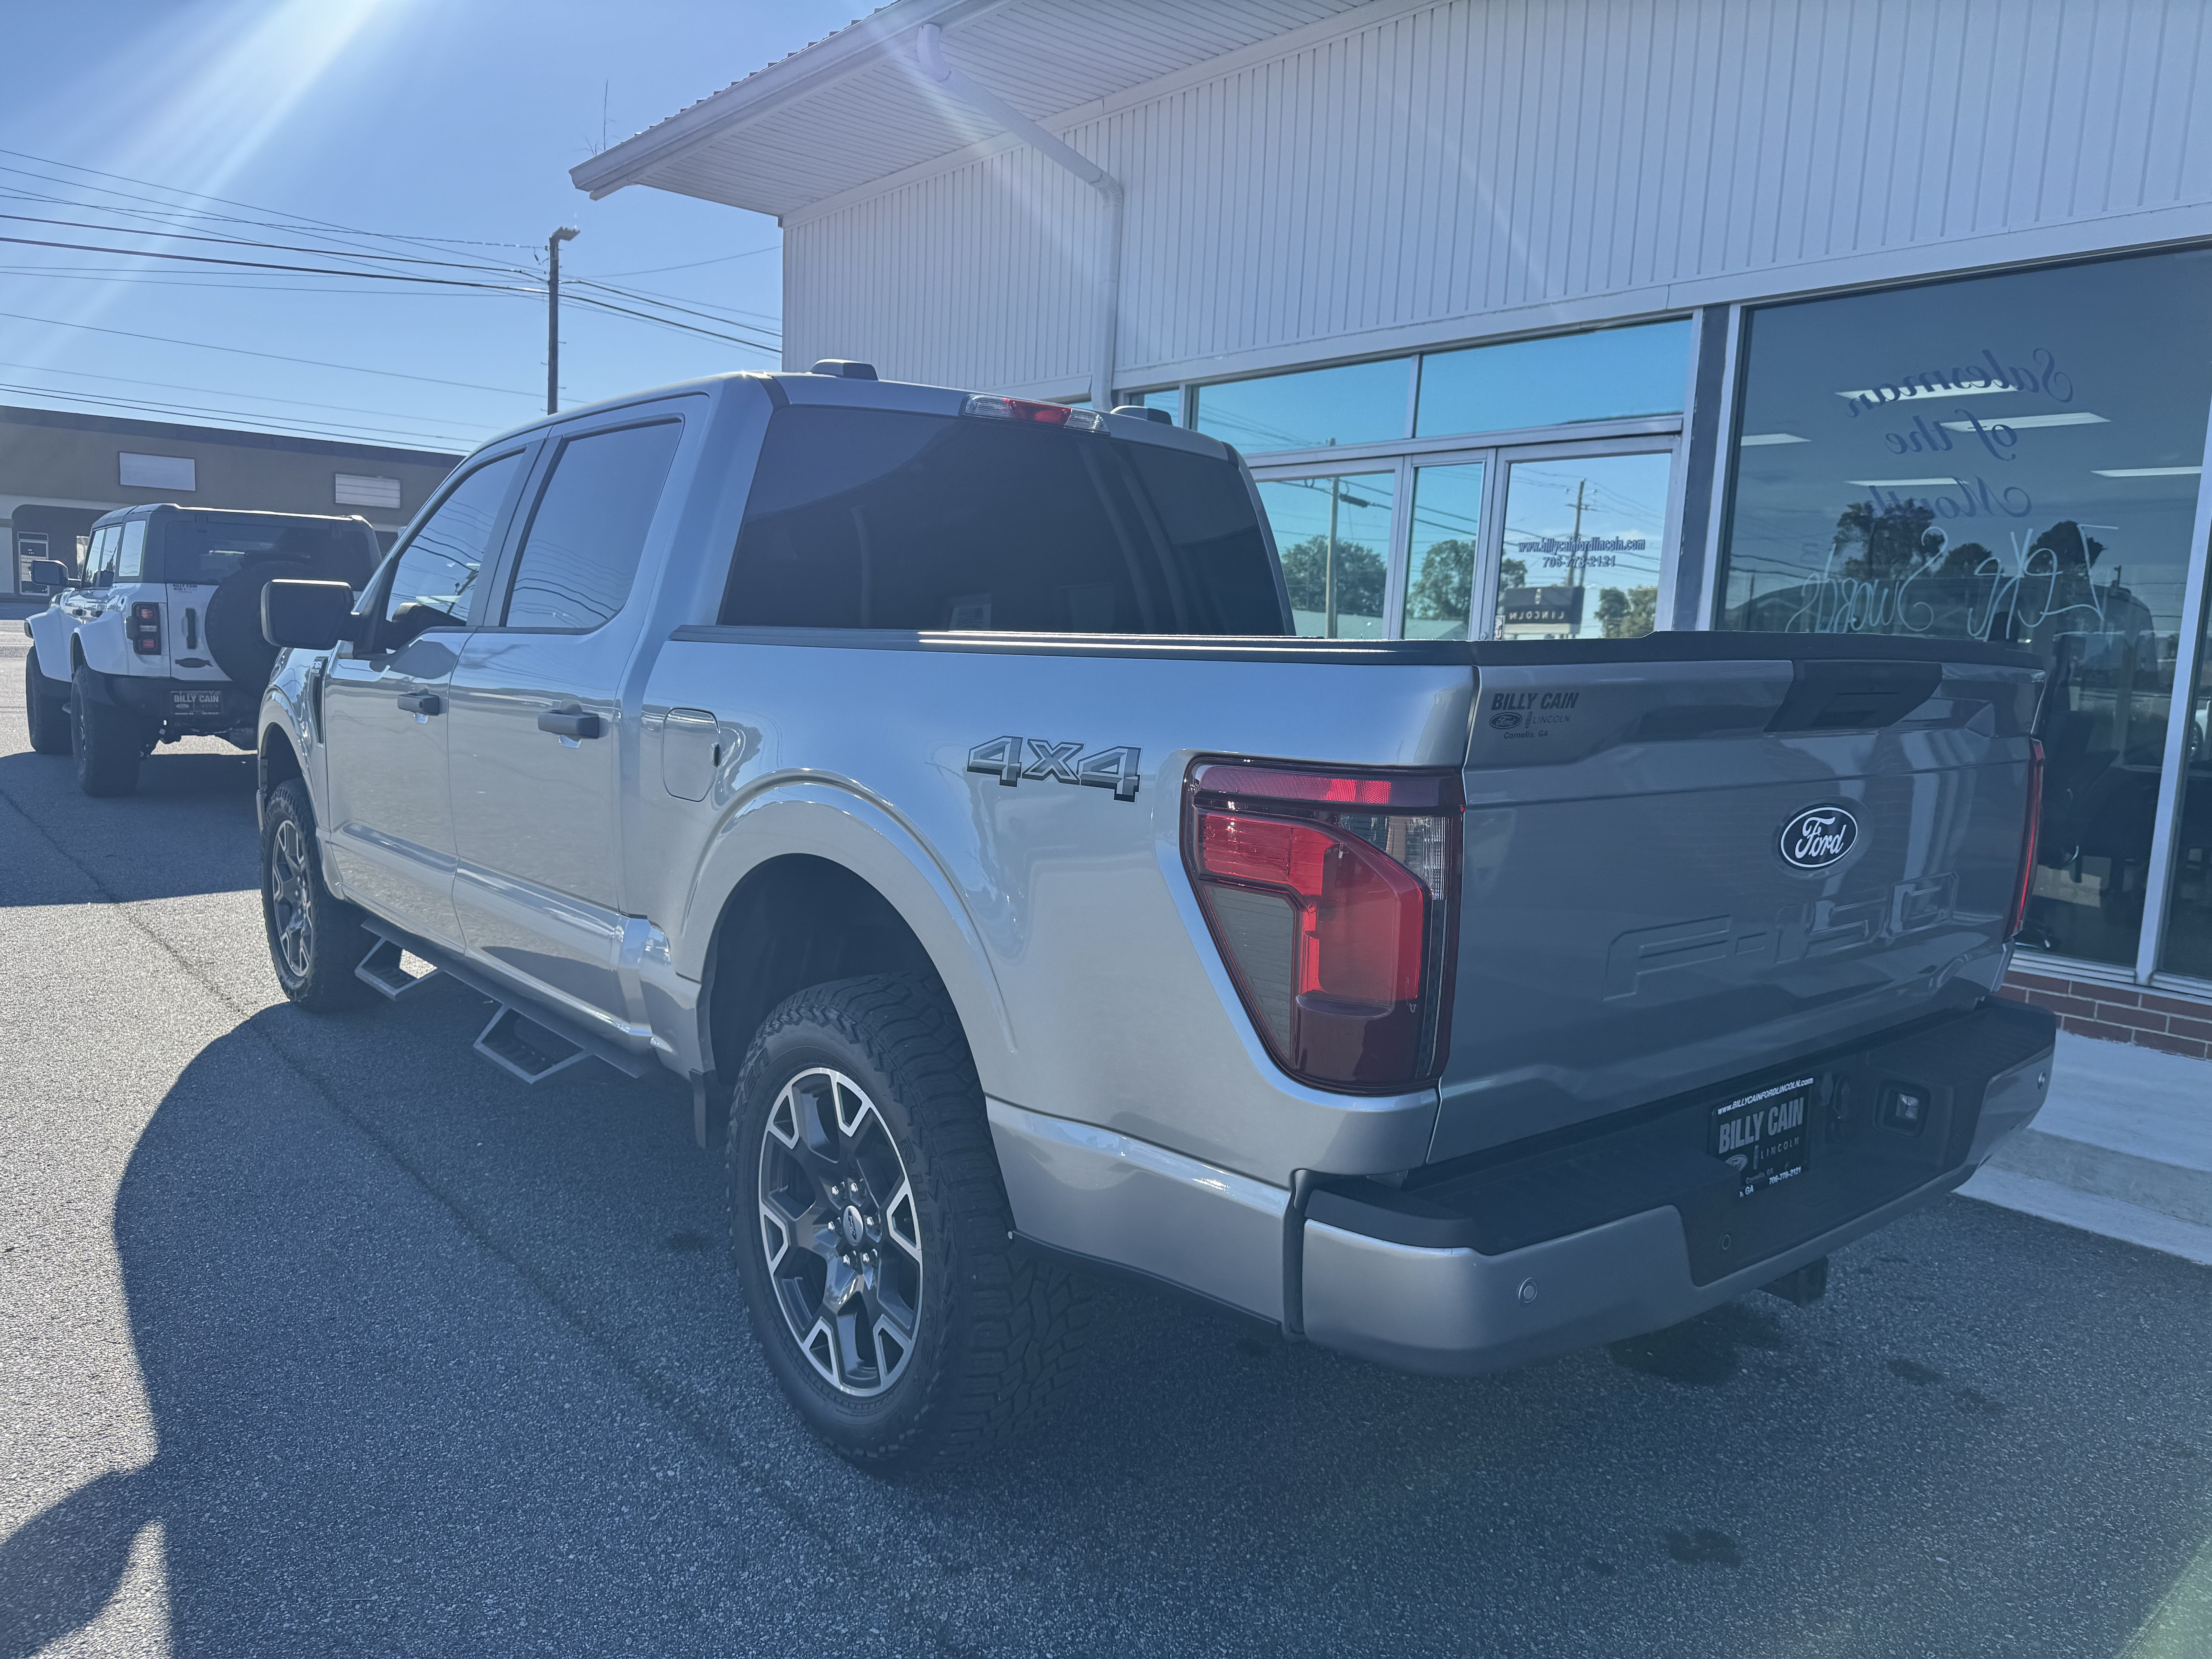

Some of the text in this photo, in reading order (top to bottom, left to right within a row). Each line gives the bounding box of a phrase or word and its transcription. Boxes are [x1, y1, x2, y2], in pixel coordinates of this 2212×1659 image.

[1518, 536, 1645, 554] www.billycainfordlincoln.com
[1542, 555, 1616, 568] 706-778-2121
[1491, 692, 1579, 710] BILLY CAIN
[1533, 715, 1570, 724] LINCOLN
[1795, 816, 1845, 859] Ford
[1602, 871, 1959, 1001] F-150
[1717, 1077, 1814, 1115] www.BILLYCAINFORDLINCOLN.com
[1719, 1097, 1804, 1154] BILLY CAIN
[1760, 1137, 1799, 1159] LINCOLN
[1745, 1185, 1754, 1195] GA
[1769, 1166, 1802, 1185] 706-778-2121
